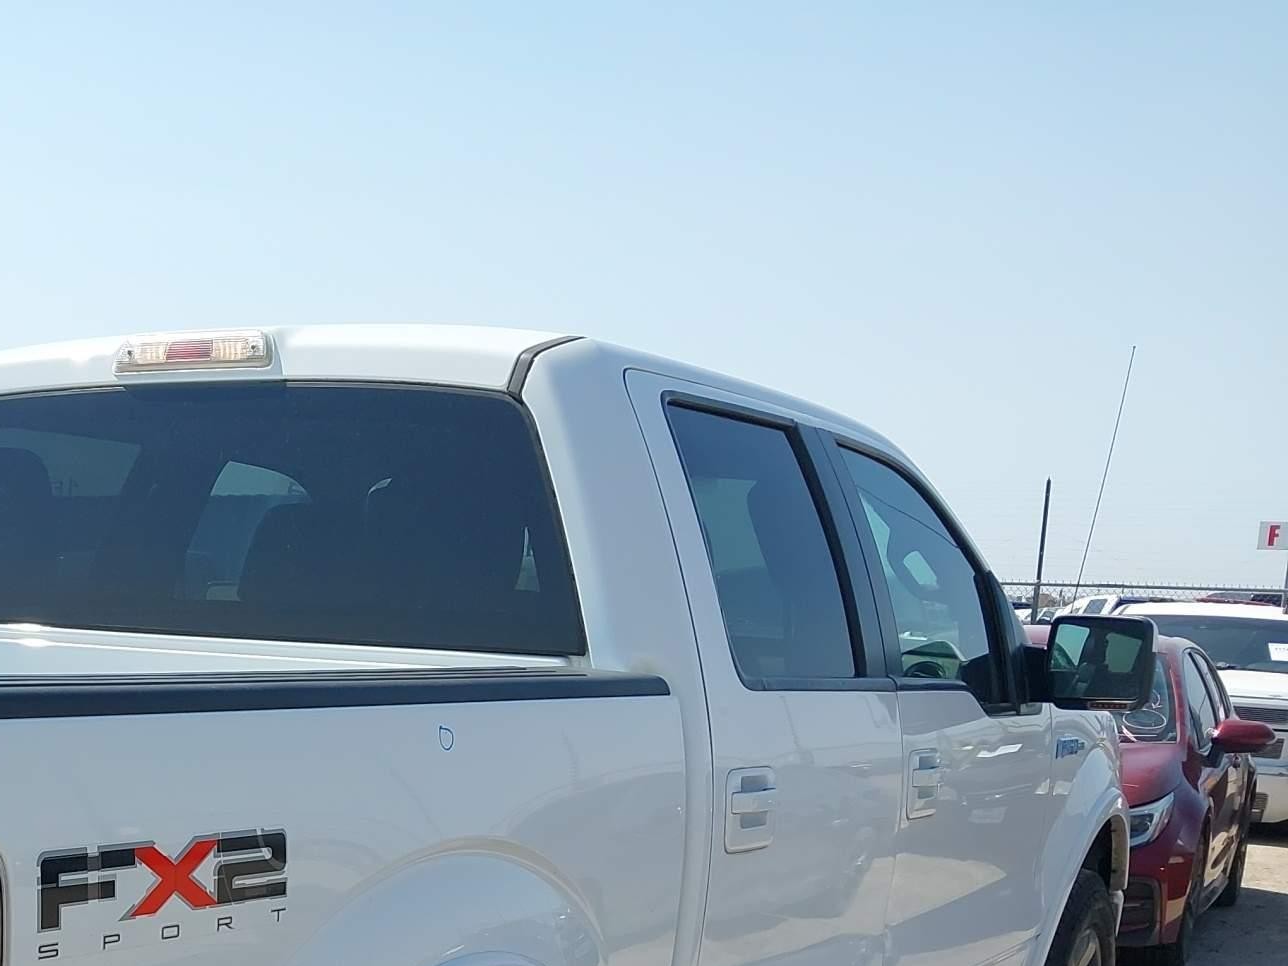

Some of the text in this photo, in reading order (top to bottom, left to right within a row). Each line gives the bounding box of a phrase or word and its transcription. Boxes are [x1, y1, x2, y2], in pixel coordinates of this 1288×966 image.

[1267, 524, 1281, 547] F
[37, 828, 288, 933] FX2
[37, 907, 287, 960] SPORT
